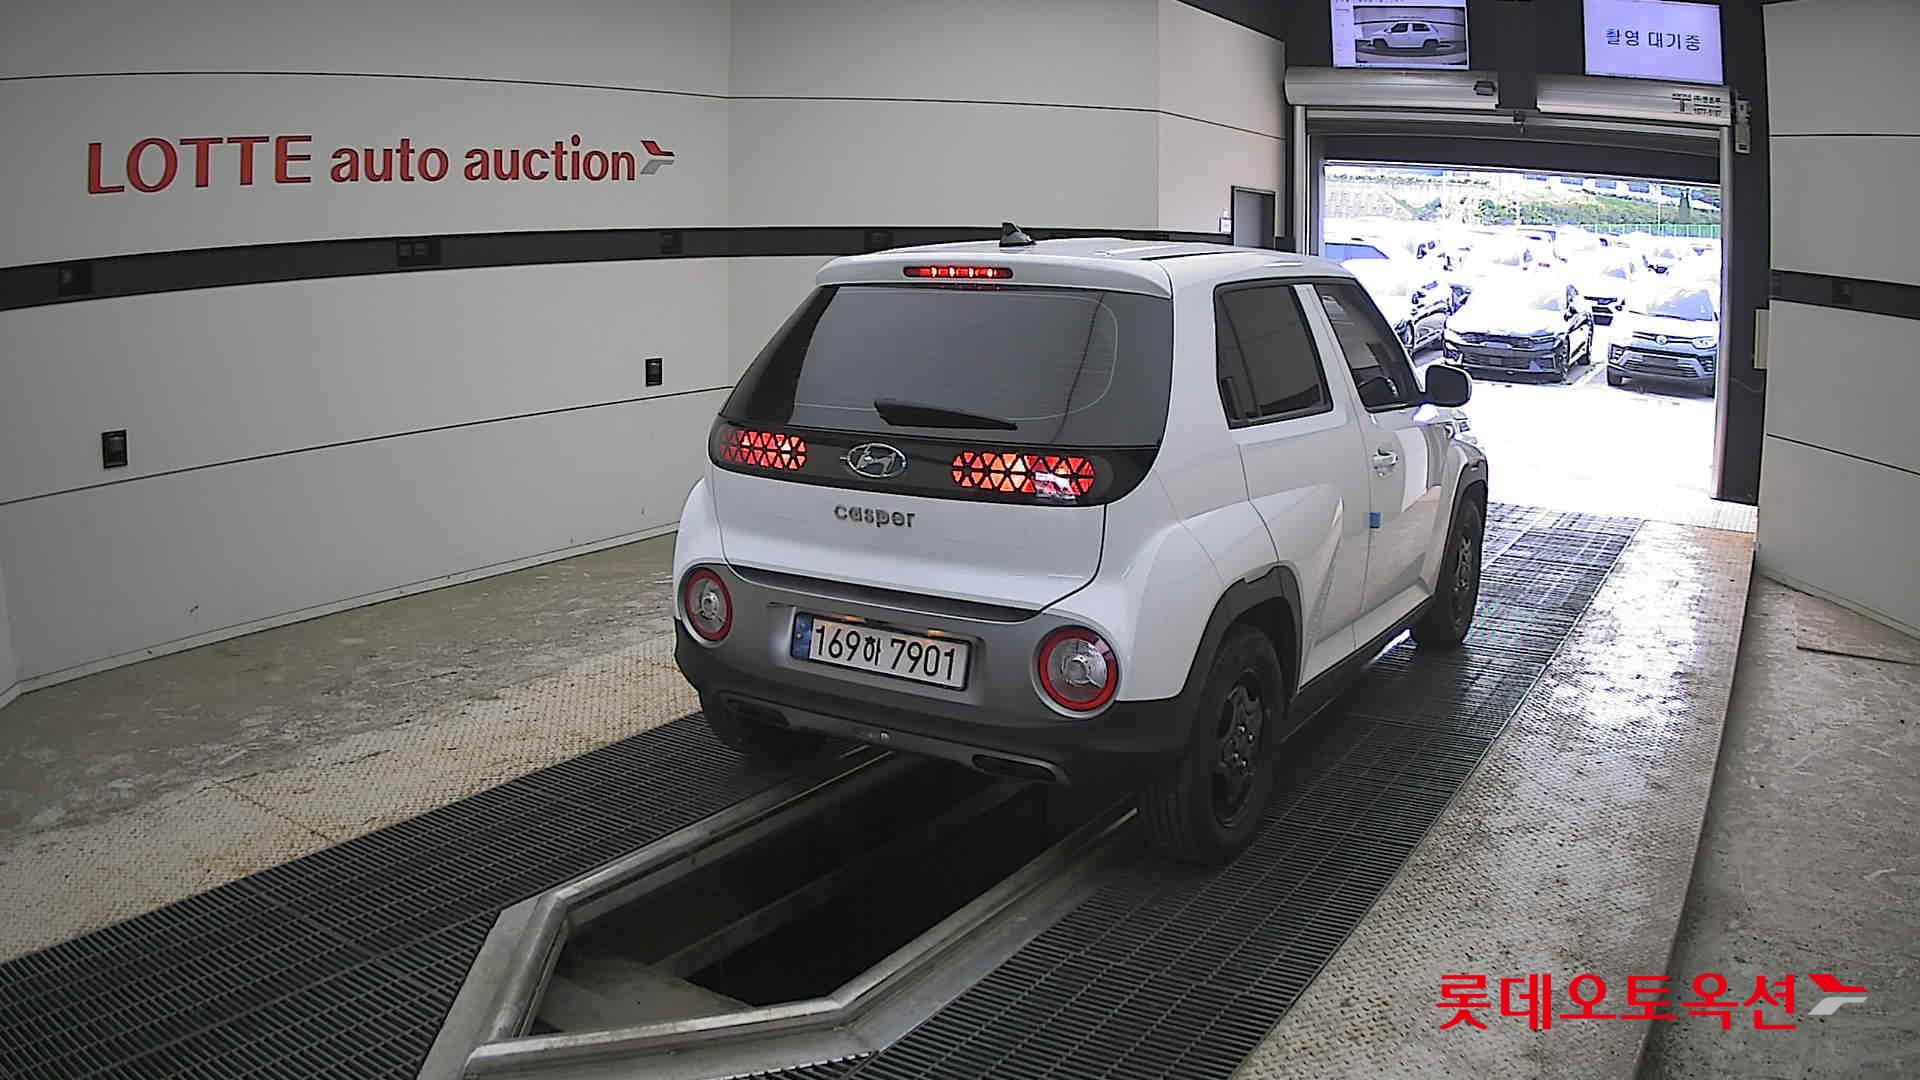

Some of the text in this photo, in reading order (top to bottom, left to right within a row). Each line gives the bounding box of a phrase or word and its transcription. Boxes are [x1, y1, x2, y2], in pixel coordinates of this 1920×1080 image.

[1648, 31, 1701, 51] 대기중
[87, 134, 637, 194] LOTTE auto auction
[834, 504, 915, 528] casper
[815, 625, 956, 681] 169하 7901
